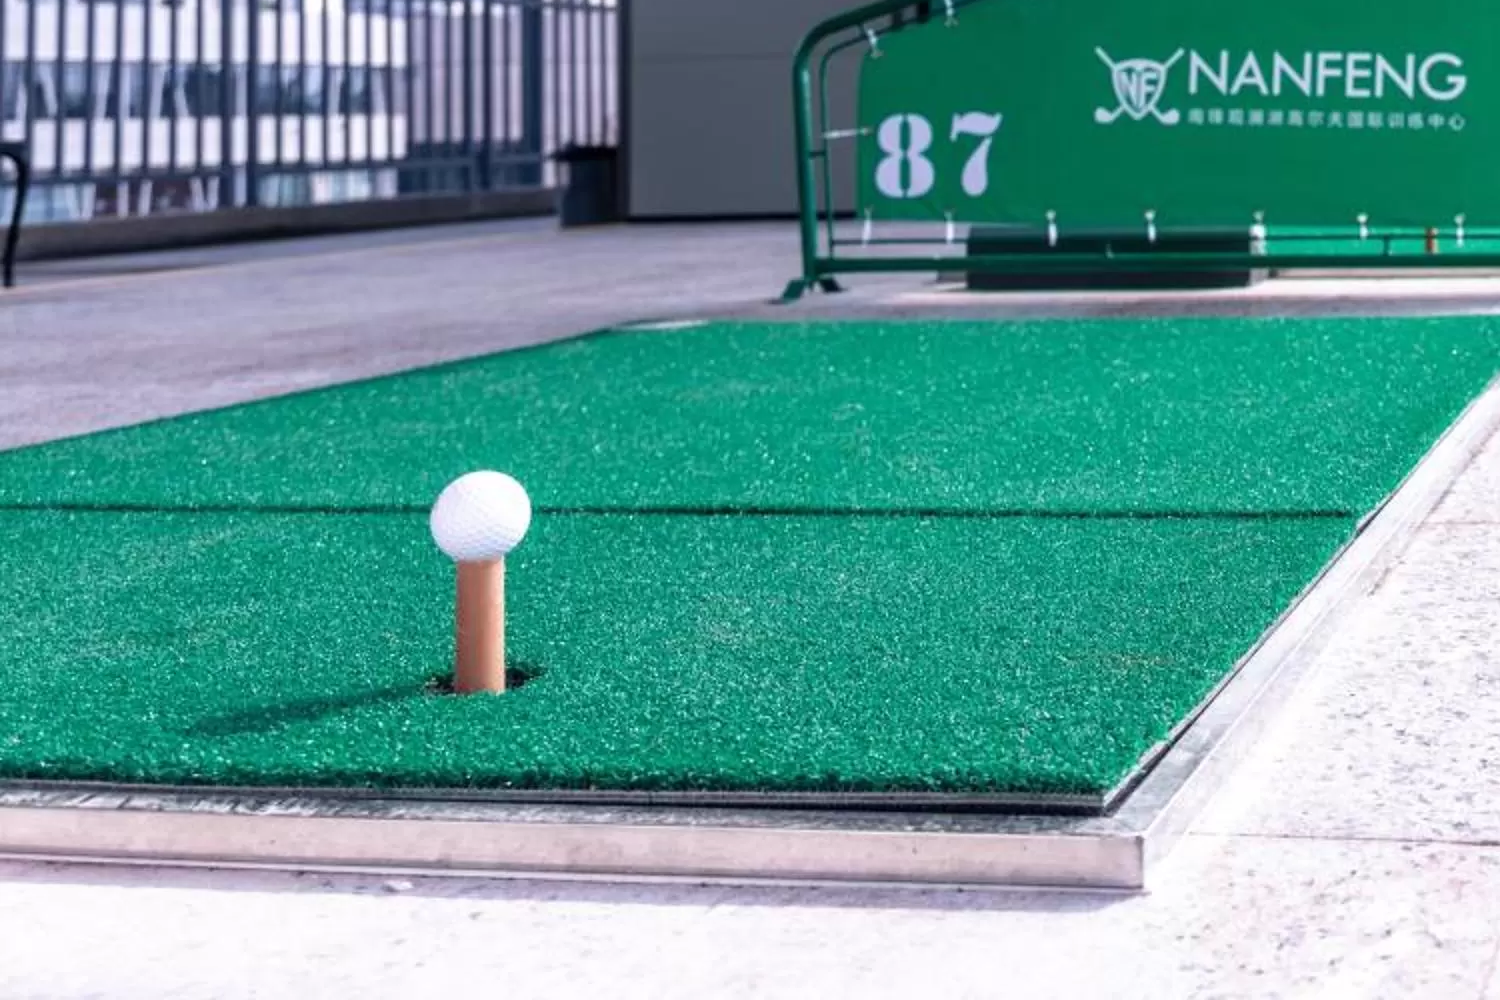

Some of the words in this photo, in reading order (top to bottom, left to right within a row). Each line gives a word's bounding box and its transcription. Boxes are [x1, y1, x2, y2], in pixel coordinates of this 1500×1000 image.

[1116, 66, 1158, 107] NF
[1188, 49, 1467, 100] NANFENG
[874, 111, 1002, 198] 87
